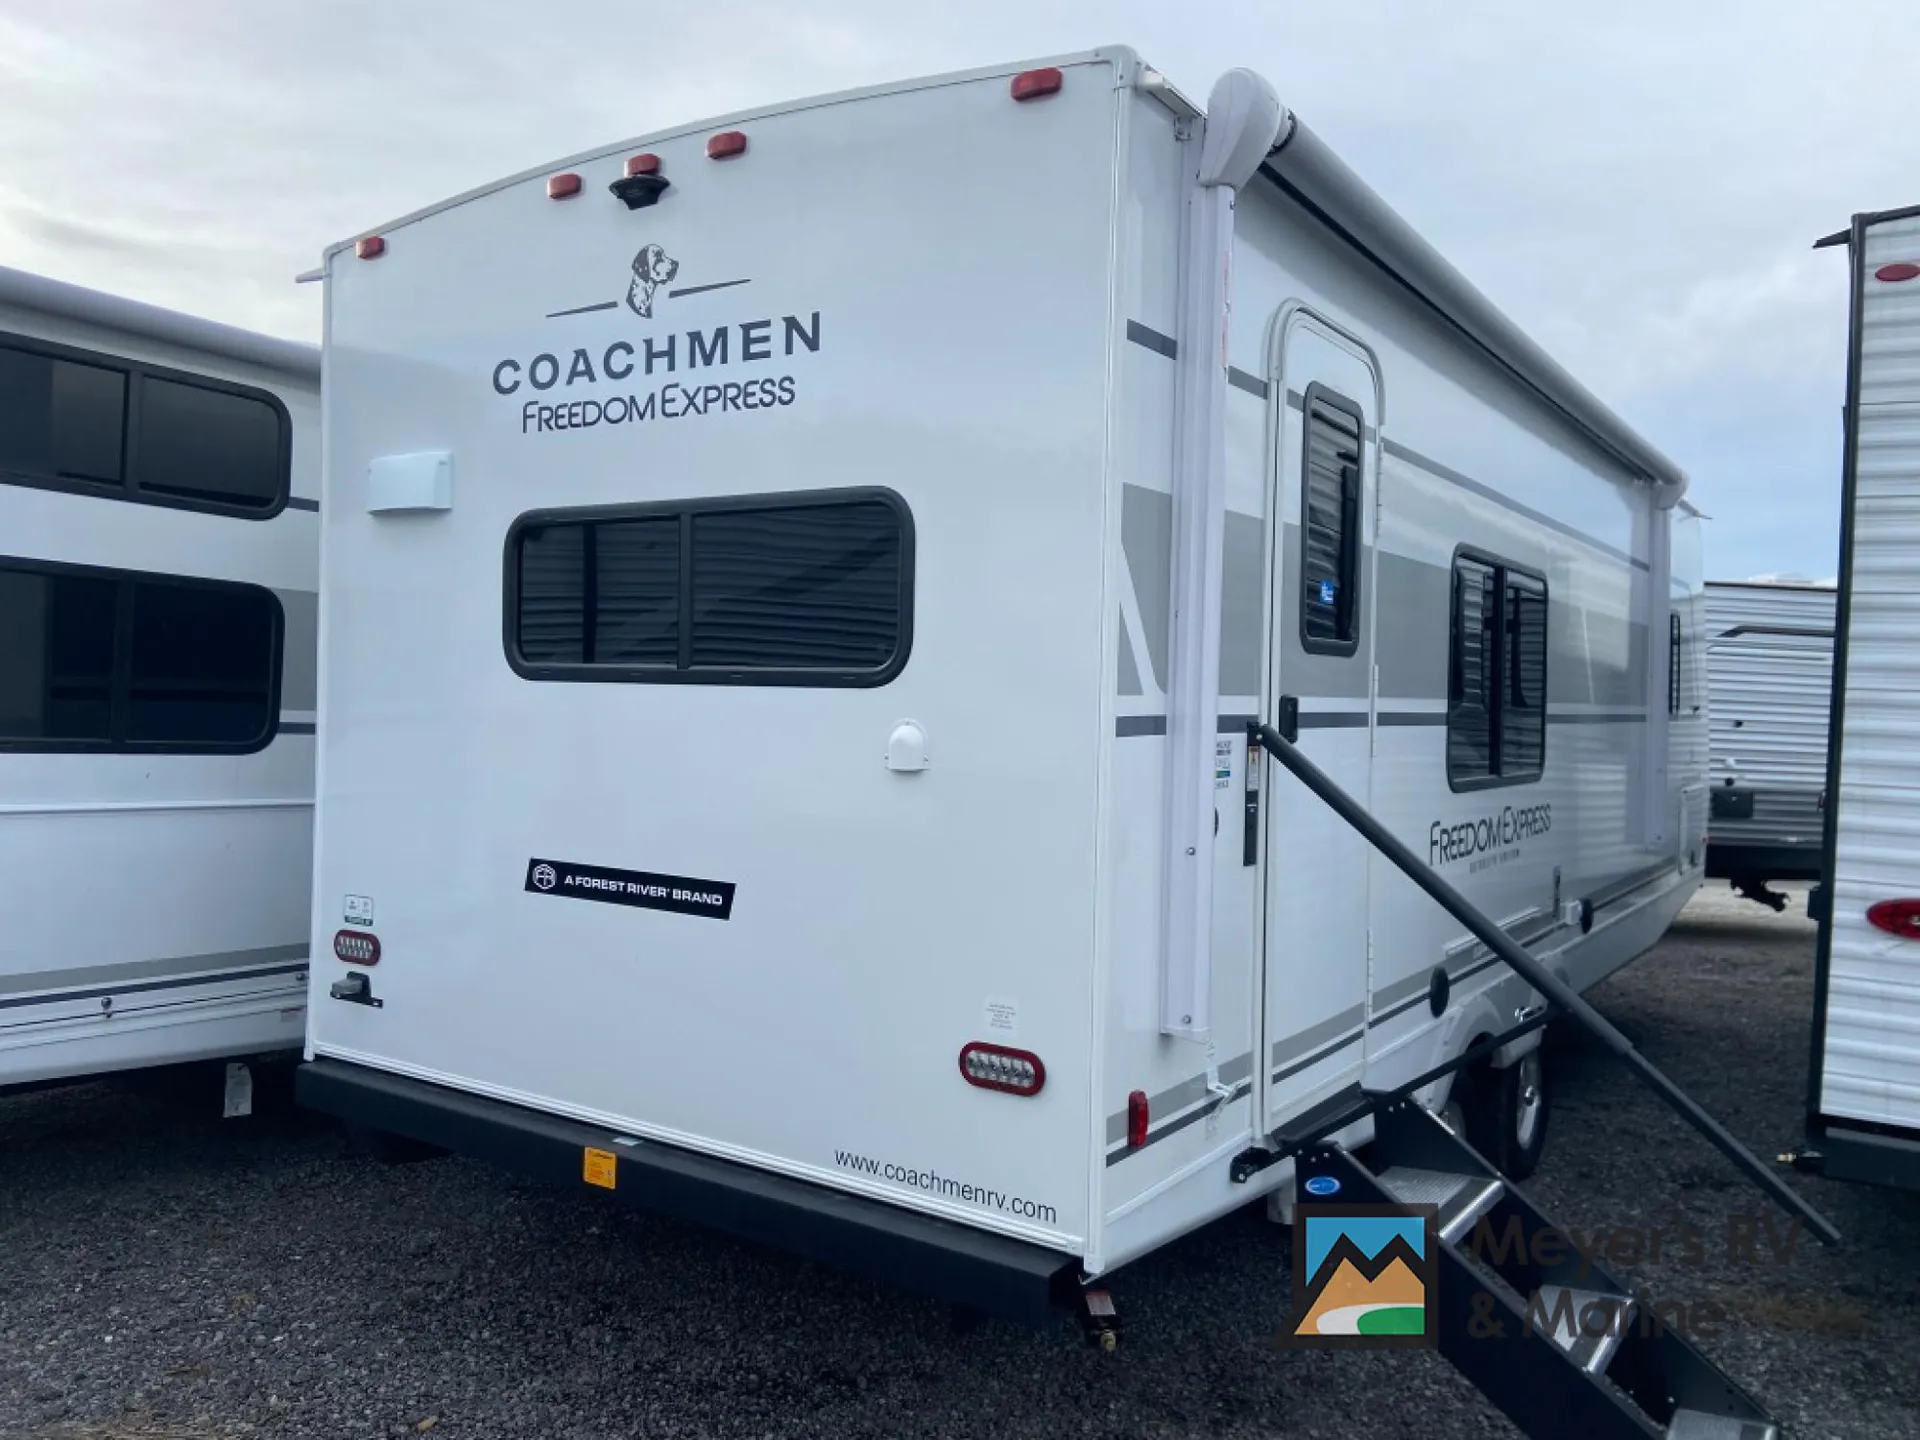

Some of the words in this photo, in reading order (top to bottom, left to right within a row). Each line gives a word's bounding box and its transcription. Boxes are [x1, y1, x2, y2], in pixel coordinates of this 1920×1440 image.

[492, 311, 821, 395] COACHMEN
[564, 874, 575, 886] A
[575, 876, 625, 892] FOREST
[672, 888, 723, 906] BRAND
[834, 1149, 1057, 1225] www.coachmenrv.com
